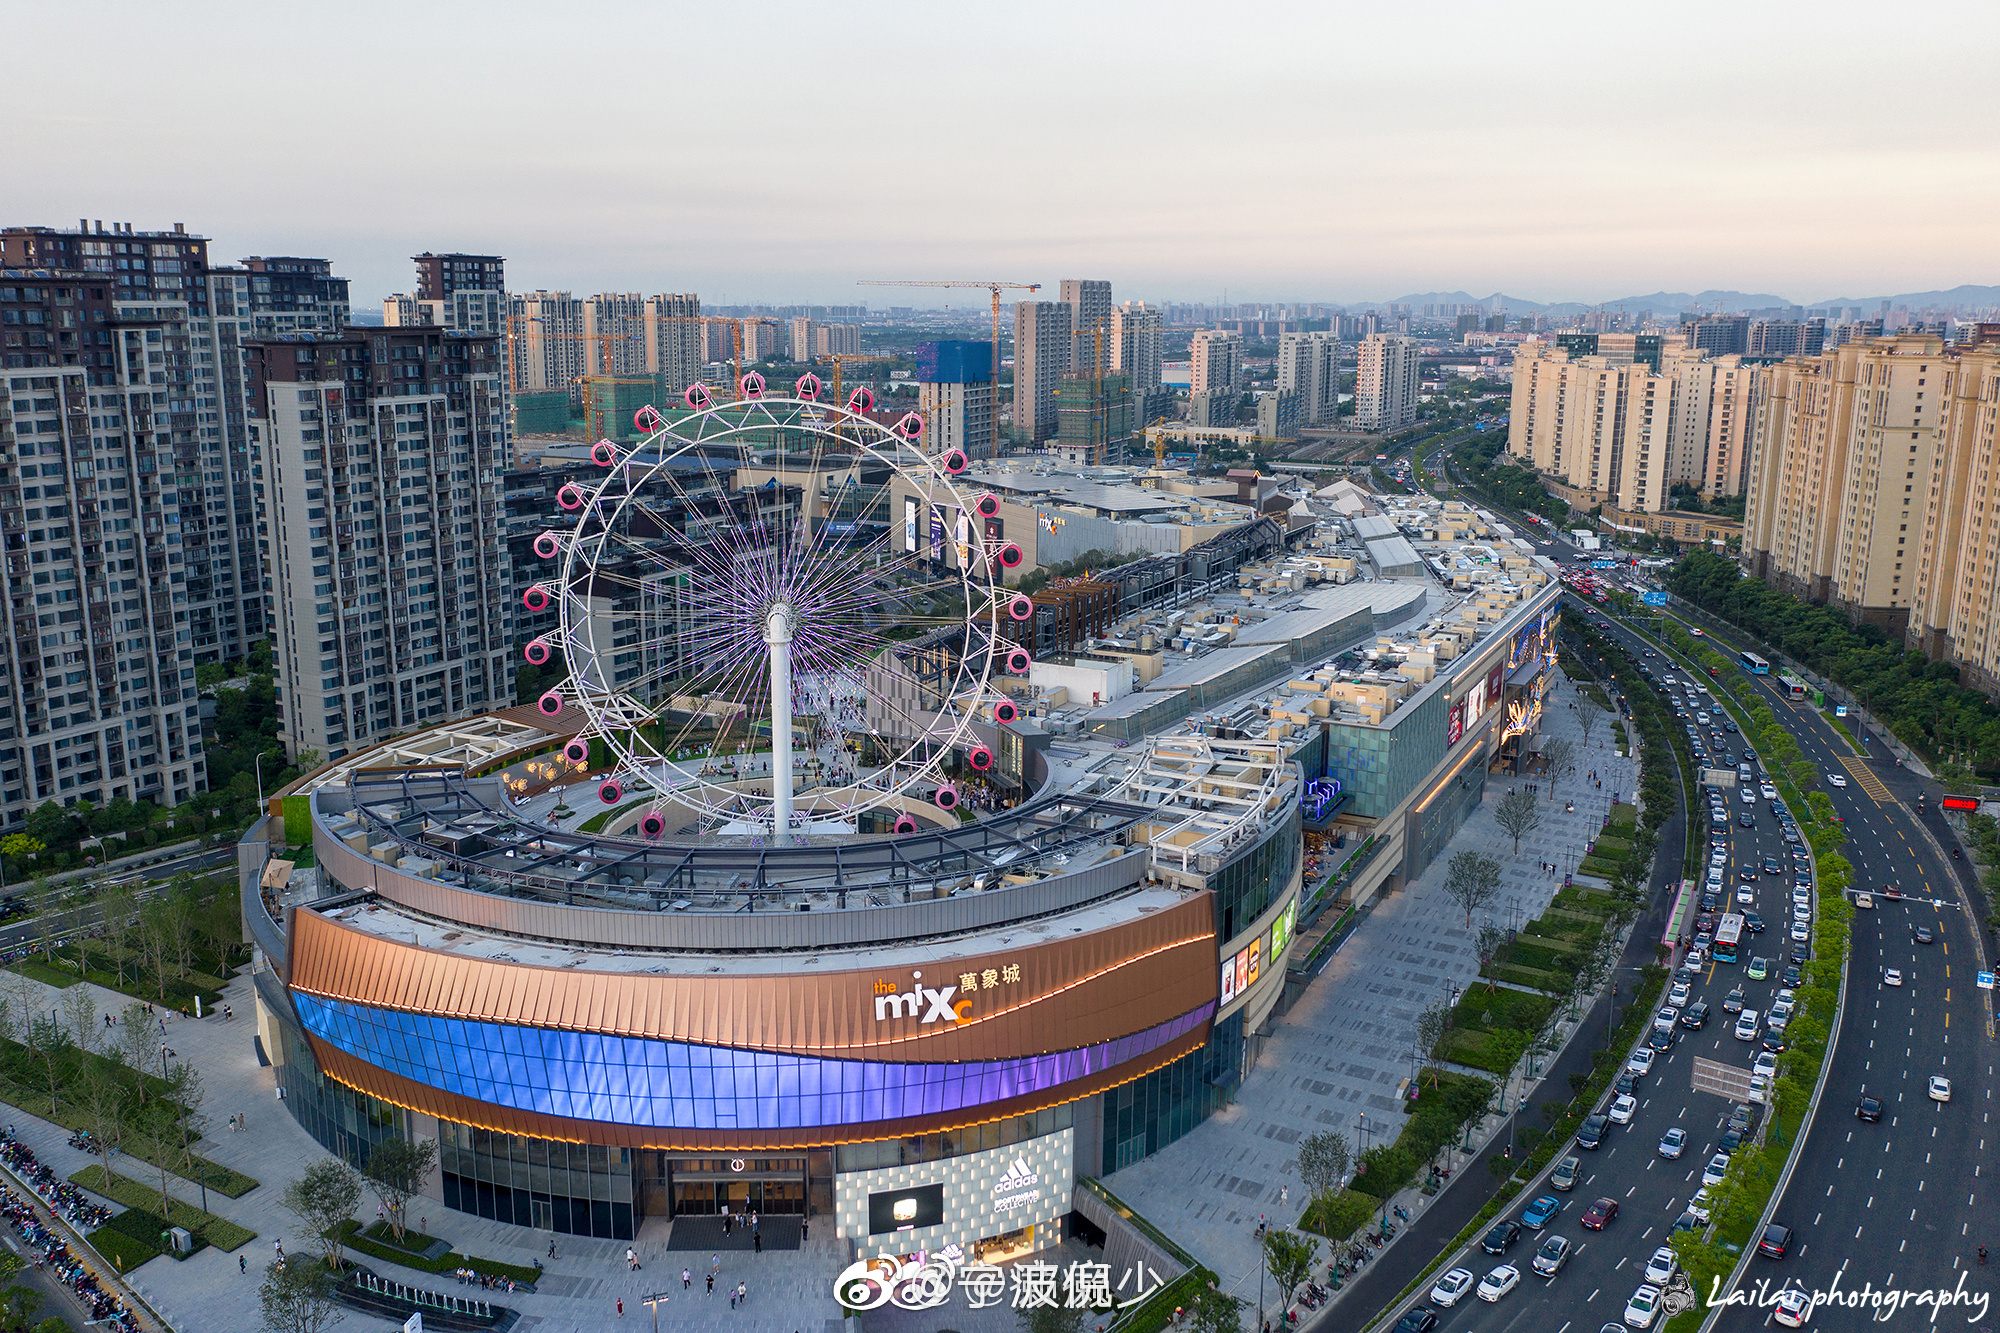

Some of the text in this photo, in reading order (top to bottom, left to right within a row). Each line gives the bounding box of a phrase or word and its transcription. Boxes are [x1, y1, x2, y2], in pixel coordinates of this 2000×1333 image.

[874, 978, 897, 994] the
[959, 963, 1021, 994] 萬象城
[994, 1173, 1038, 1194] adidas
[993, 1198, 1038, 1213] COLLECTIVE
